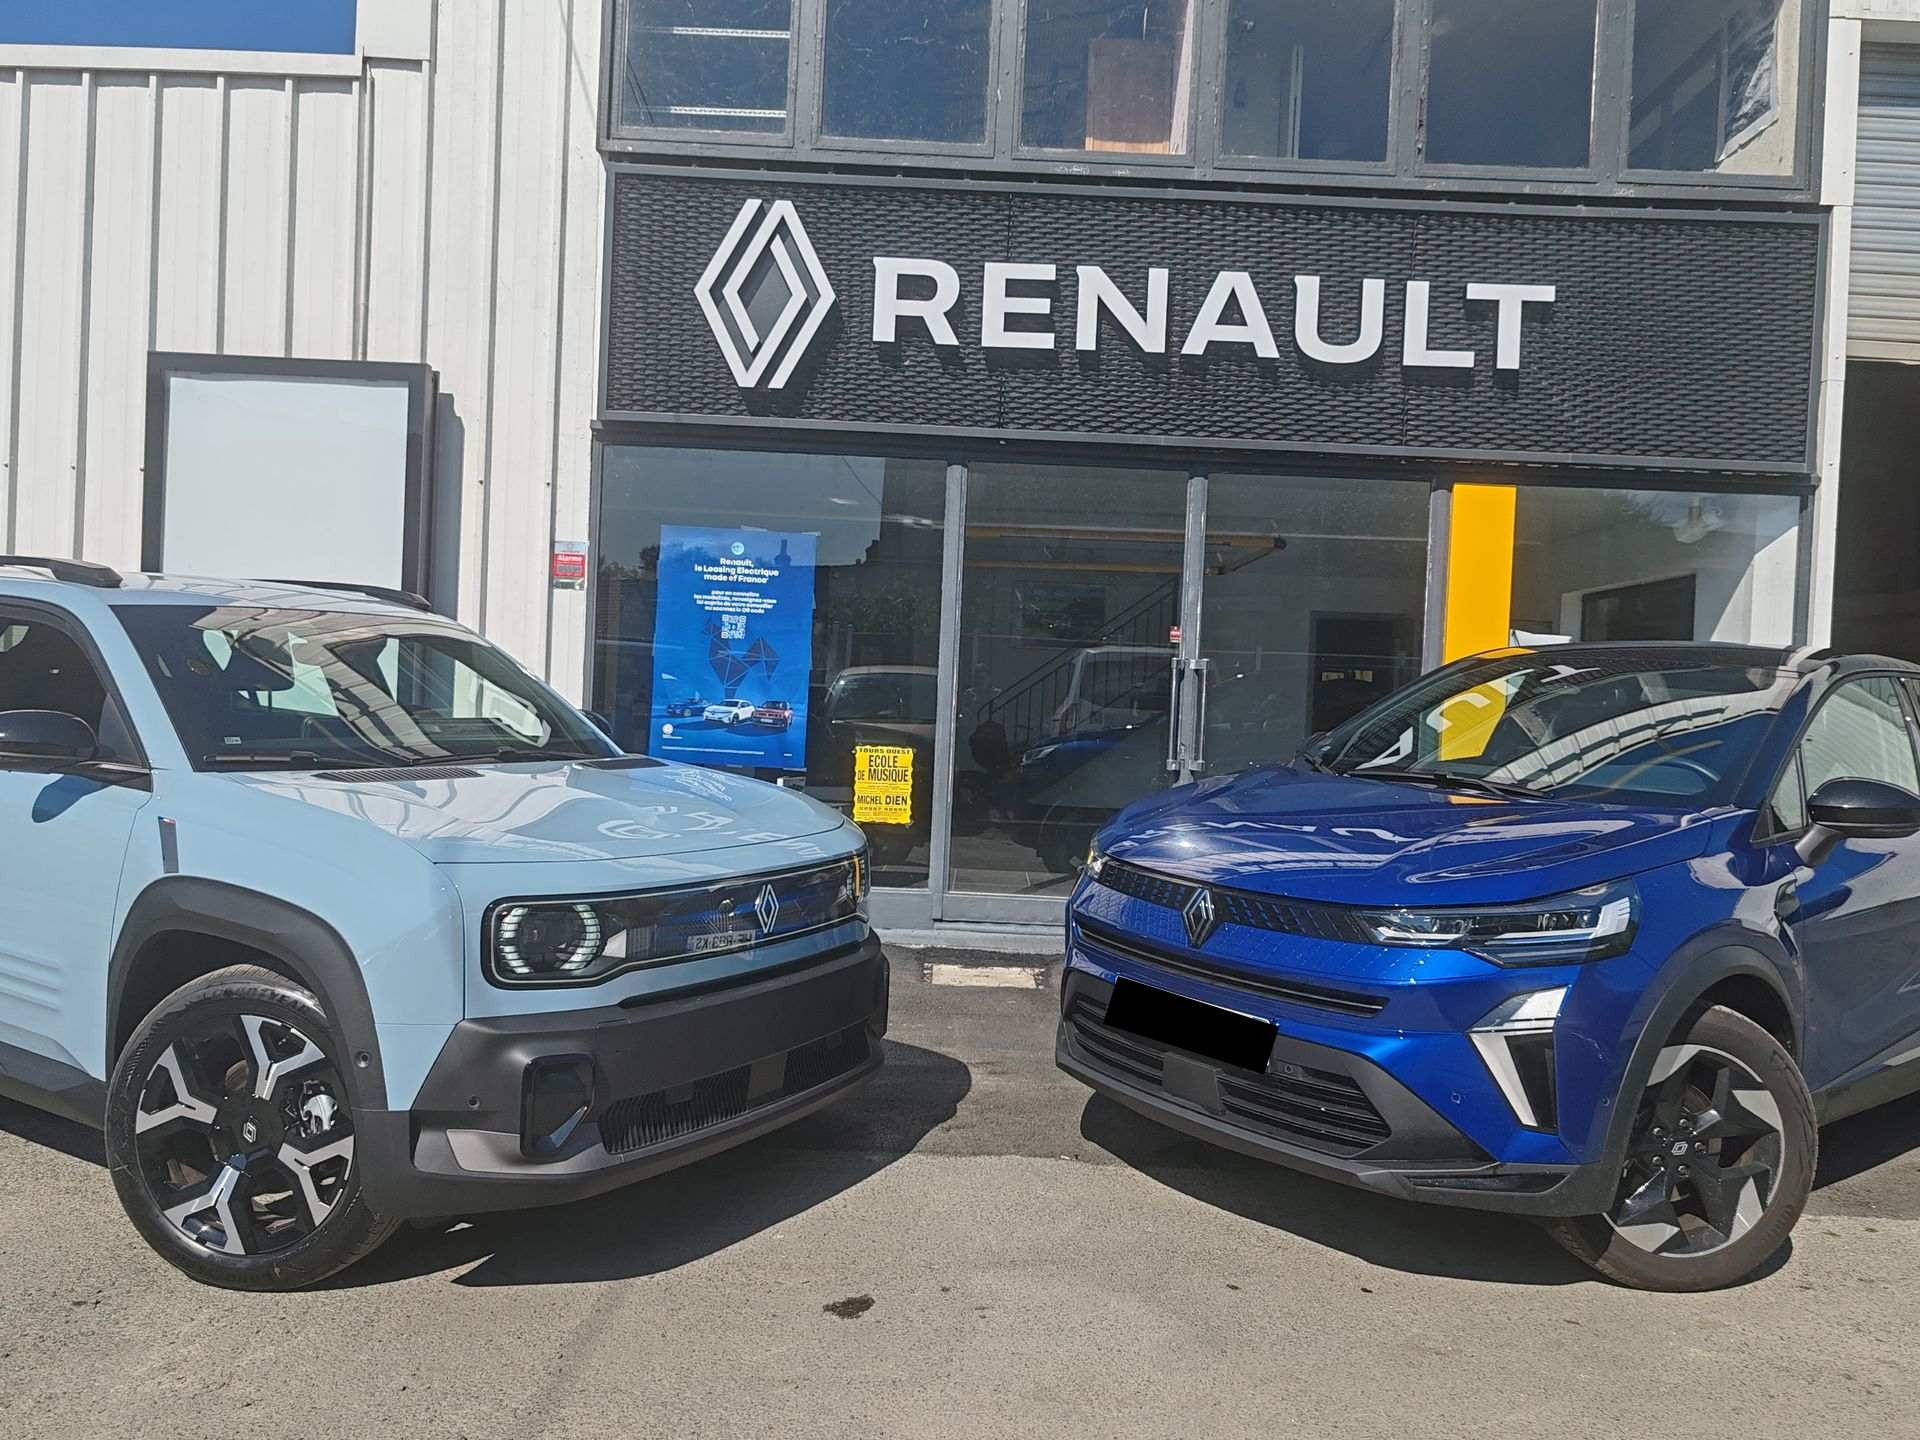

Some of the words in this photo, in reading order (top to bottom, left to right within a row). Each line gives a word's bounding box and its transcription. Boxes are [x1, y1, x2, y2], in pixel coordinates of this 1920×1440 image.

[872, 256, 1556, 369] RENAULT
[558, 554, 583, 562] Alarme
[720, 558, 754, 568] Renault,
[694, 564, 703, 572] le
[703, 565, 736, 576] Leasing
[737, 567, 779, 577] Electrique
[868, 754, 898, 768] ECOLE
[857, 769, 865, 781] DE
[867, 768, 909, 783] MUSIQUE
[857, 795, 882, 805] MICHEL
[885, 795, 908, 806] DIEN
